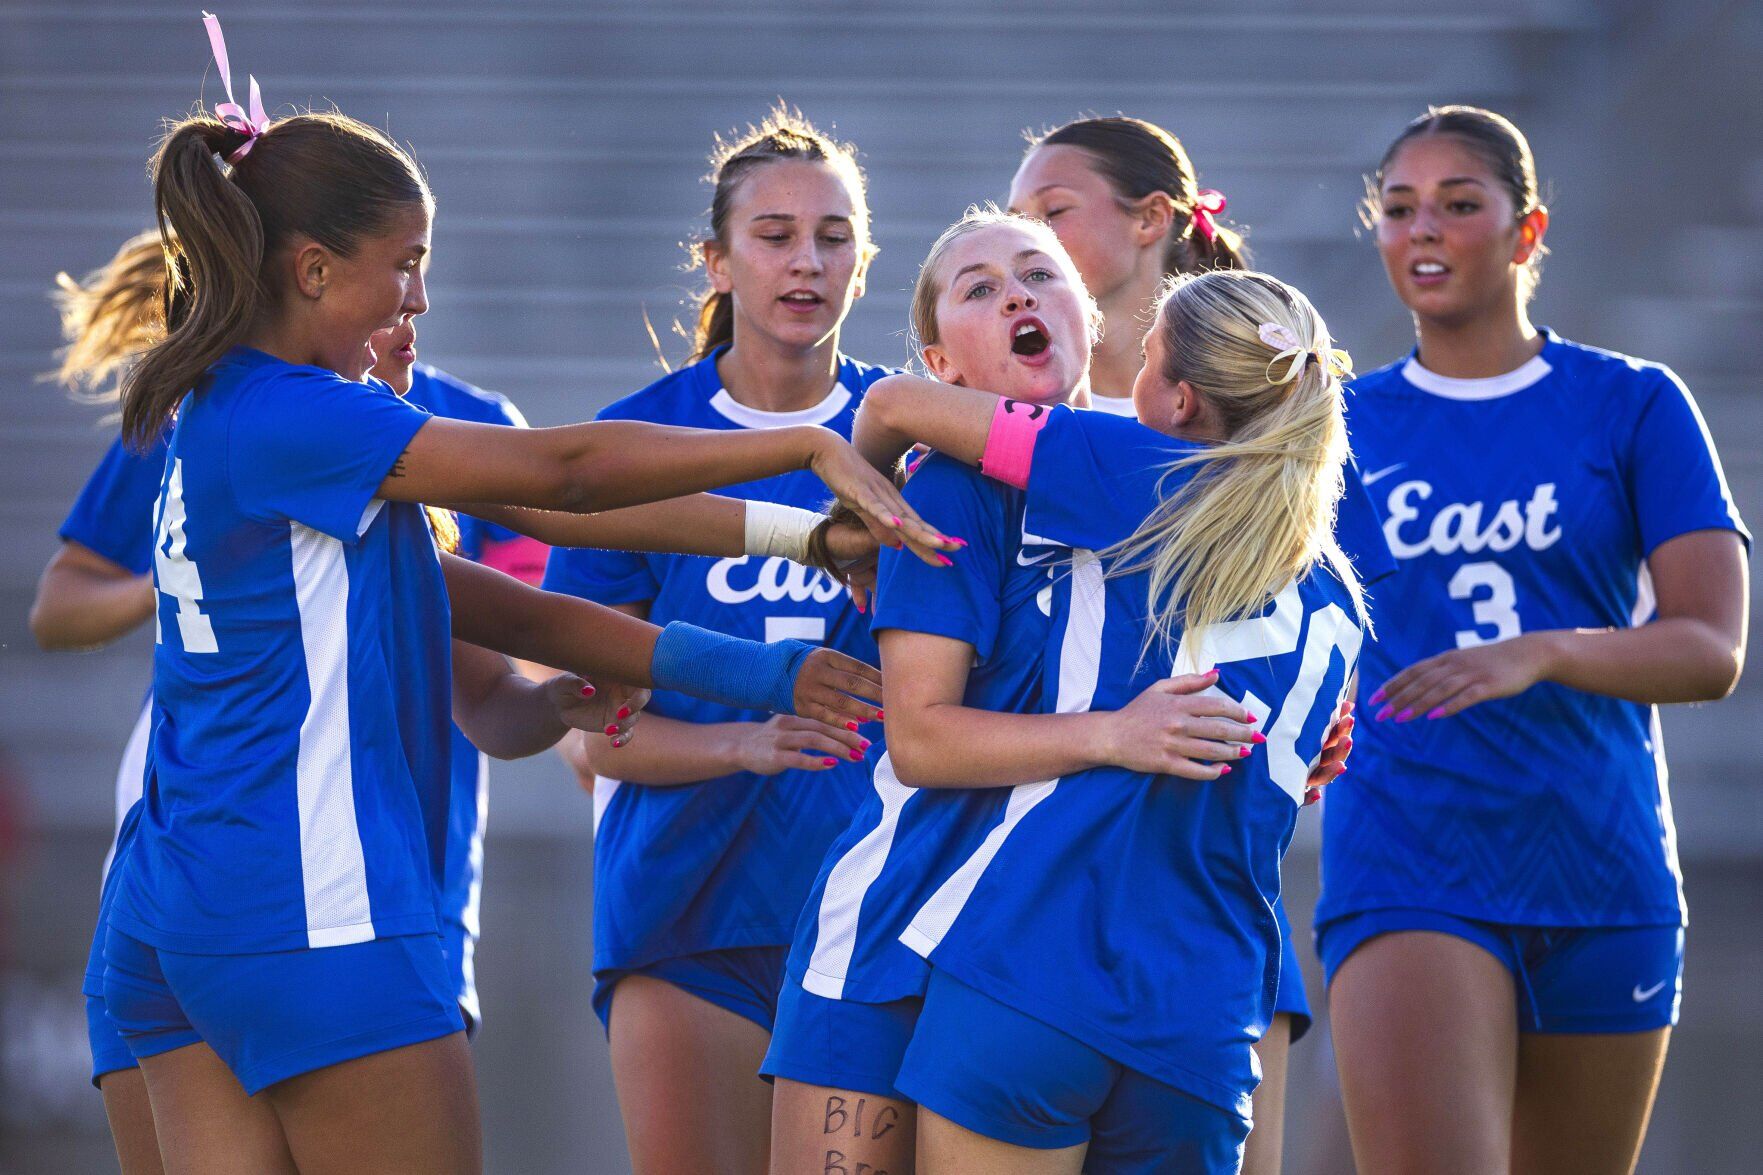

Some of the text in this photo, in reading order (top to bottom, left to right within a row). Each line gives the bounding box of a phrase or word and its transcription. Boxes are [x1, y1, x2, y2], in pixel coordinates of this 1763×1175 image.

[153, 455, 219, 653] 4
[1382, 480, 1562, 559] East
[706, 554, 852, 604] Eas
[1448, 561, 1522, 650] 3
[824, 1096, 899, 1140] BIG
